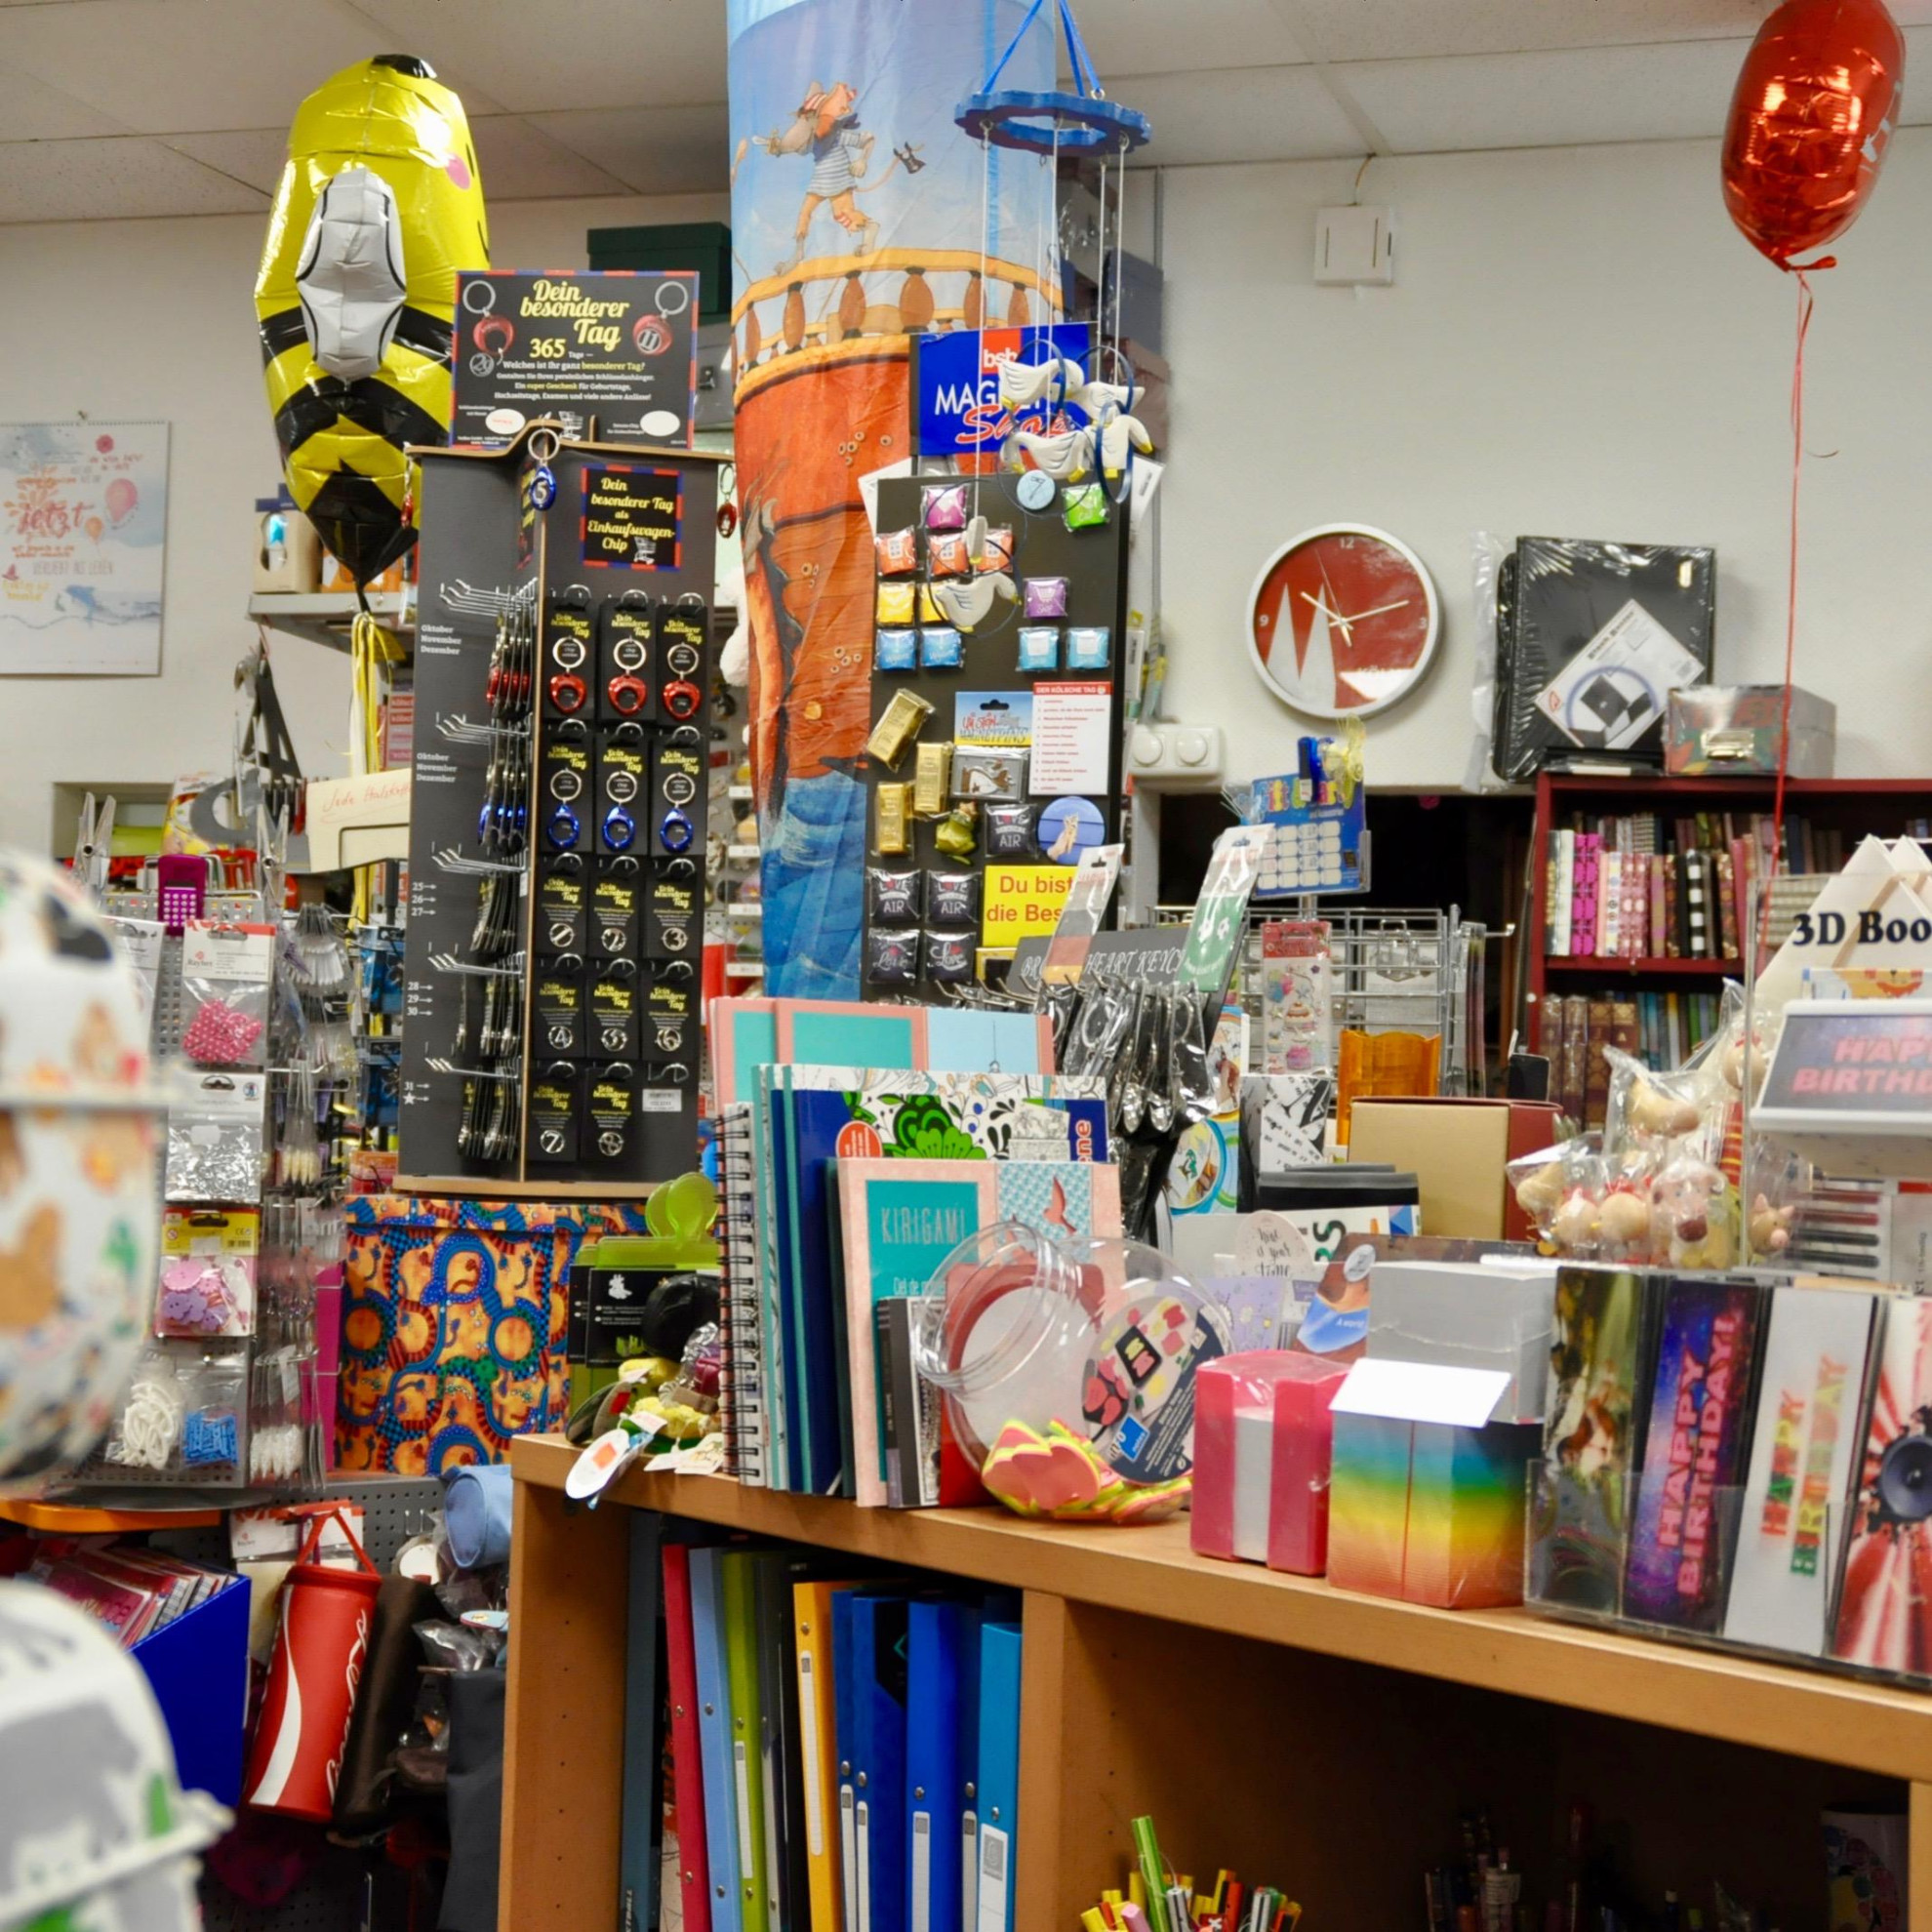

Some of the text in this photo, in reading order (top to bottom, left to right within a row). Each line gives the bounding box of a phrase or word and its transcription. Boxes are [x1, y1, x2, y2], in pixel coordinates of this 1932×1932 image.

[533, 279, 581, 302] Dein
[520, 297, 629, 318] besonderer
[574, 319, 621, 351] Tag
[530, 339, 566, 358] 365
[561, 363, 581, 373] ganz
[601, 477, 627, 491] Dein
[590, 493, 674, 514] besonderer Tag
[615, 510, 629, 519] als
[587, 520, 675, 541] Einkaufswagen-
[602, 537, 627, 553] Chip
[1340, 538, 1354, 548] 12
[1260, 615, 1268, 627] 9
[1419, 618, 1428, 629] 3
[421, 624, 454, 633] Oktober
[421, 635, 462, 645] November
[421, 646, 461, 656] Dezember
[417, 752, 449, 762] Oktober
[417, 763, 458, 773] November
[416, 774, 457, 783] Dezember
[999, 835, 1022, 847] AIR
[412, 882, 423, 891] 25
[1000, 875, 1027, 894] Du
[412, 895, 423, 904] 26
[411, 907, 423, 916] 27
[883, 901, 905, 913] AIR
[941, 902, 962, 914] AIR
[986, 904, 1062, 922] die Bes
[1792, 909, 1932, 946] 3D Boo
[1084, 948, 1136, 975] HEART
[1136, 945, 1187, 974] KEYC
[408, 982, 420, 991] 28
[407, 994, 420, 1004] 29
[407, 1007, 419, 1016] 30
[880, 1206, 966, 1245] KIRIGAMI
[1659, 1345, 1706, 1547] HAPPY
[1677, 1313, 1737, 1596] BIRTHDAY!
[1761, 1389, 1805, 1536] HAPPY
[1791, 1354, 1849, 1578] BIRTHDAY
